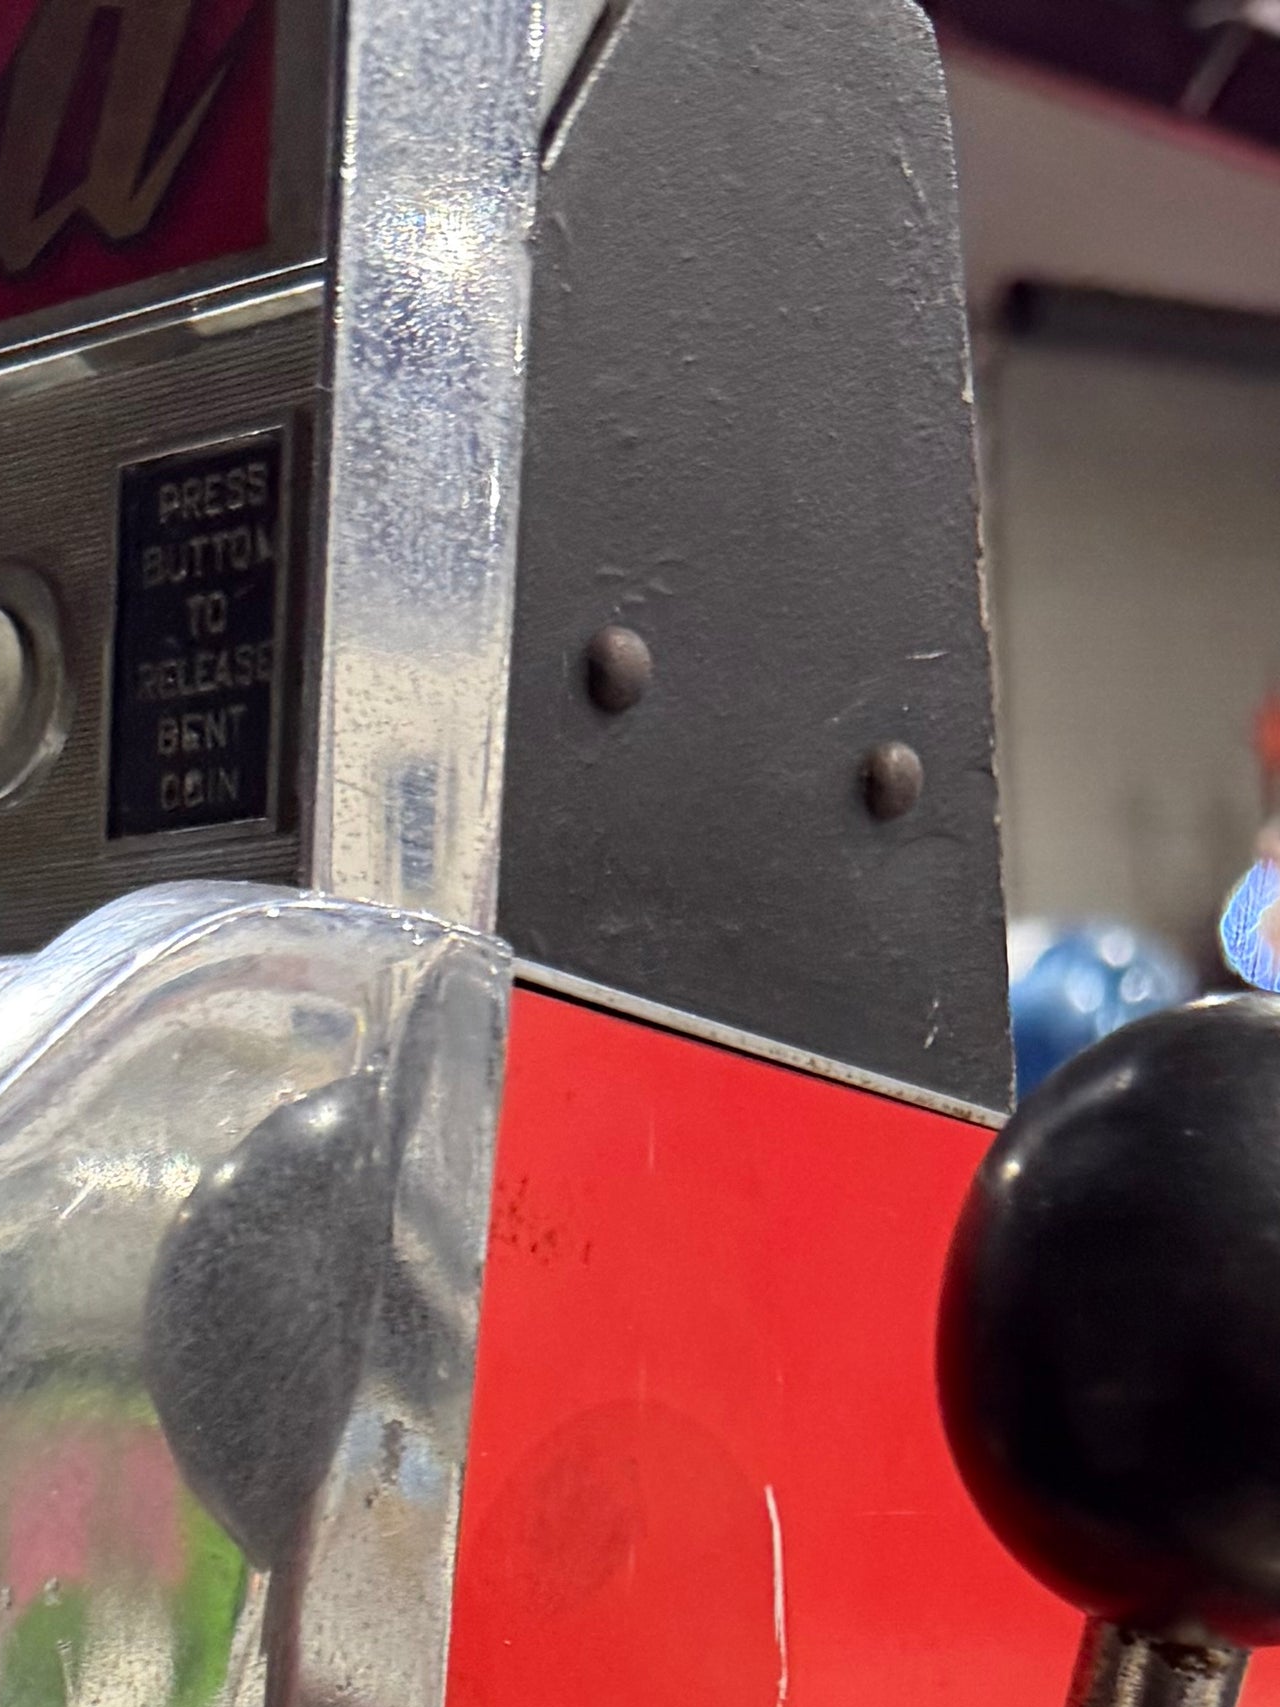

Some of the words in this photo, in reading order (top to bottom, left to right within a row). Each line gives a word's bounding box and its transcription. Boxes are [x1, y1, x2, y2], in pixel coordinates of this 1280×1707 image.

[158, 462, 268, 523] PRESS
[186, 591, 228, 638] TO
[136, 640, 274, 698] RELEASE
[157, 705, 248, 756] BENT
